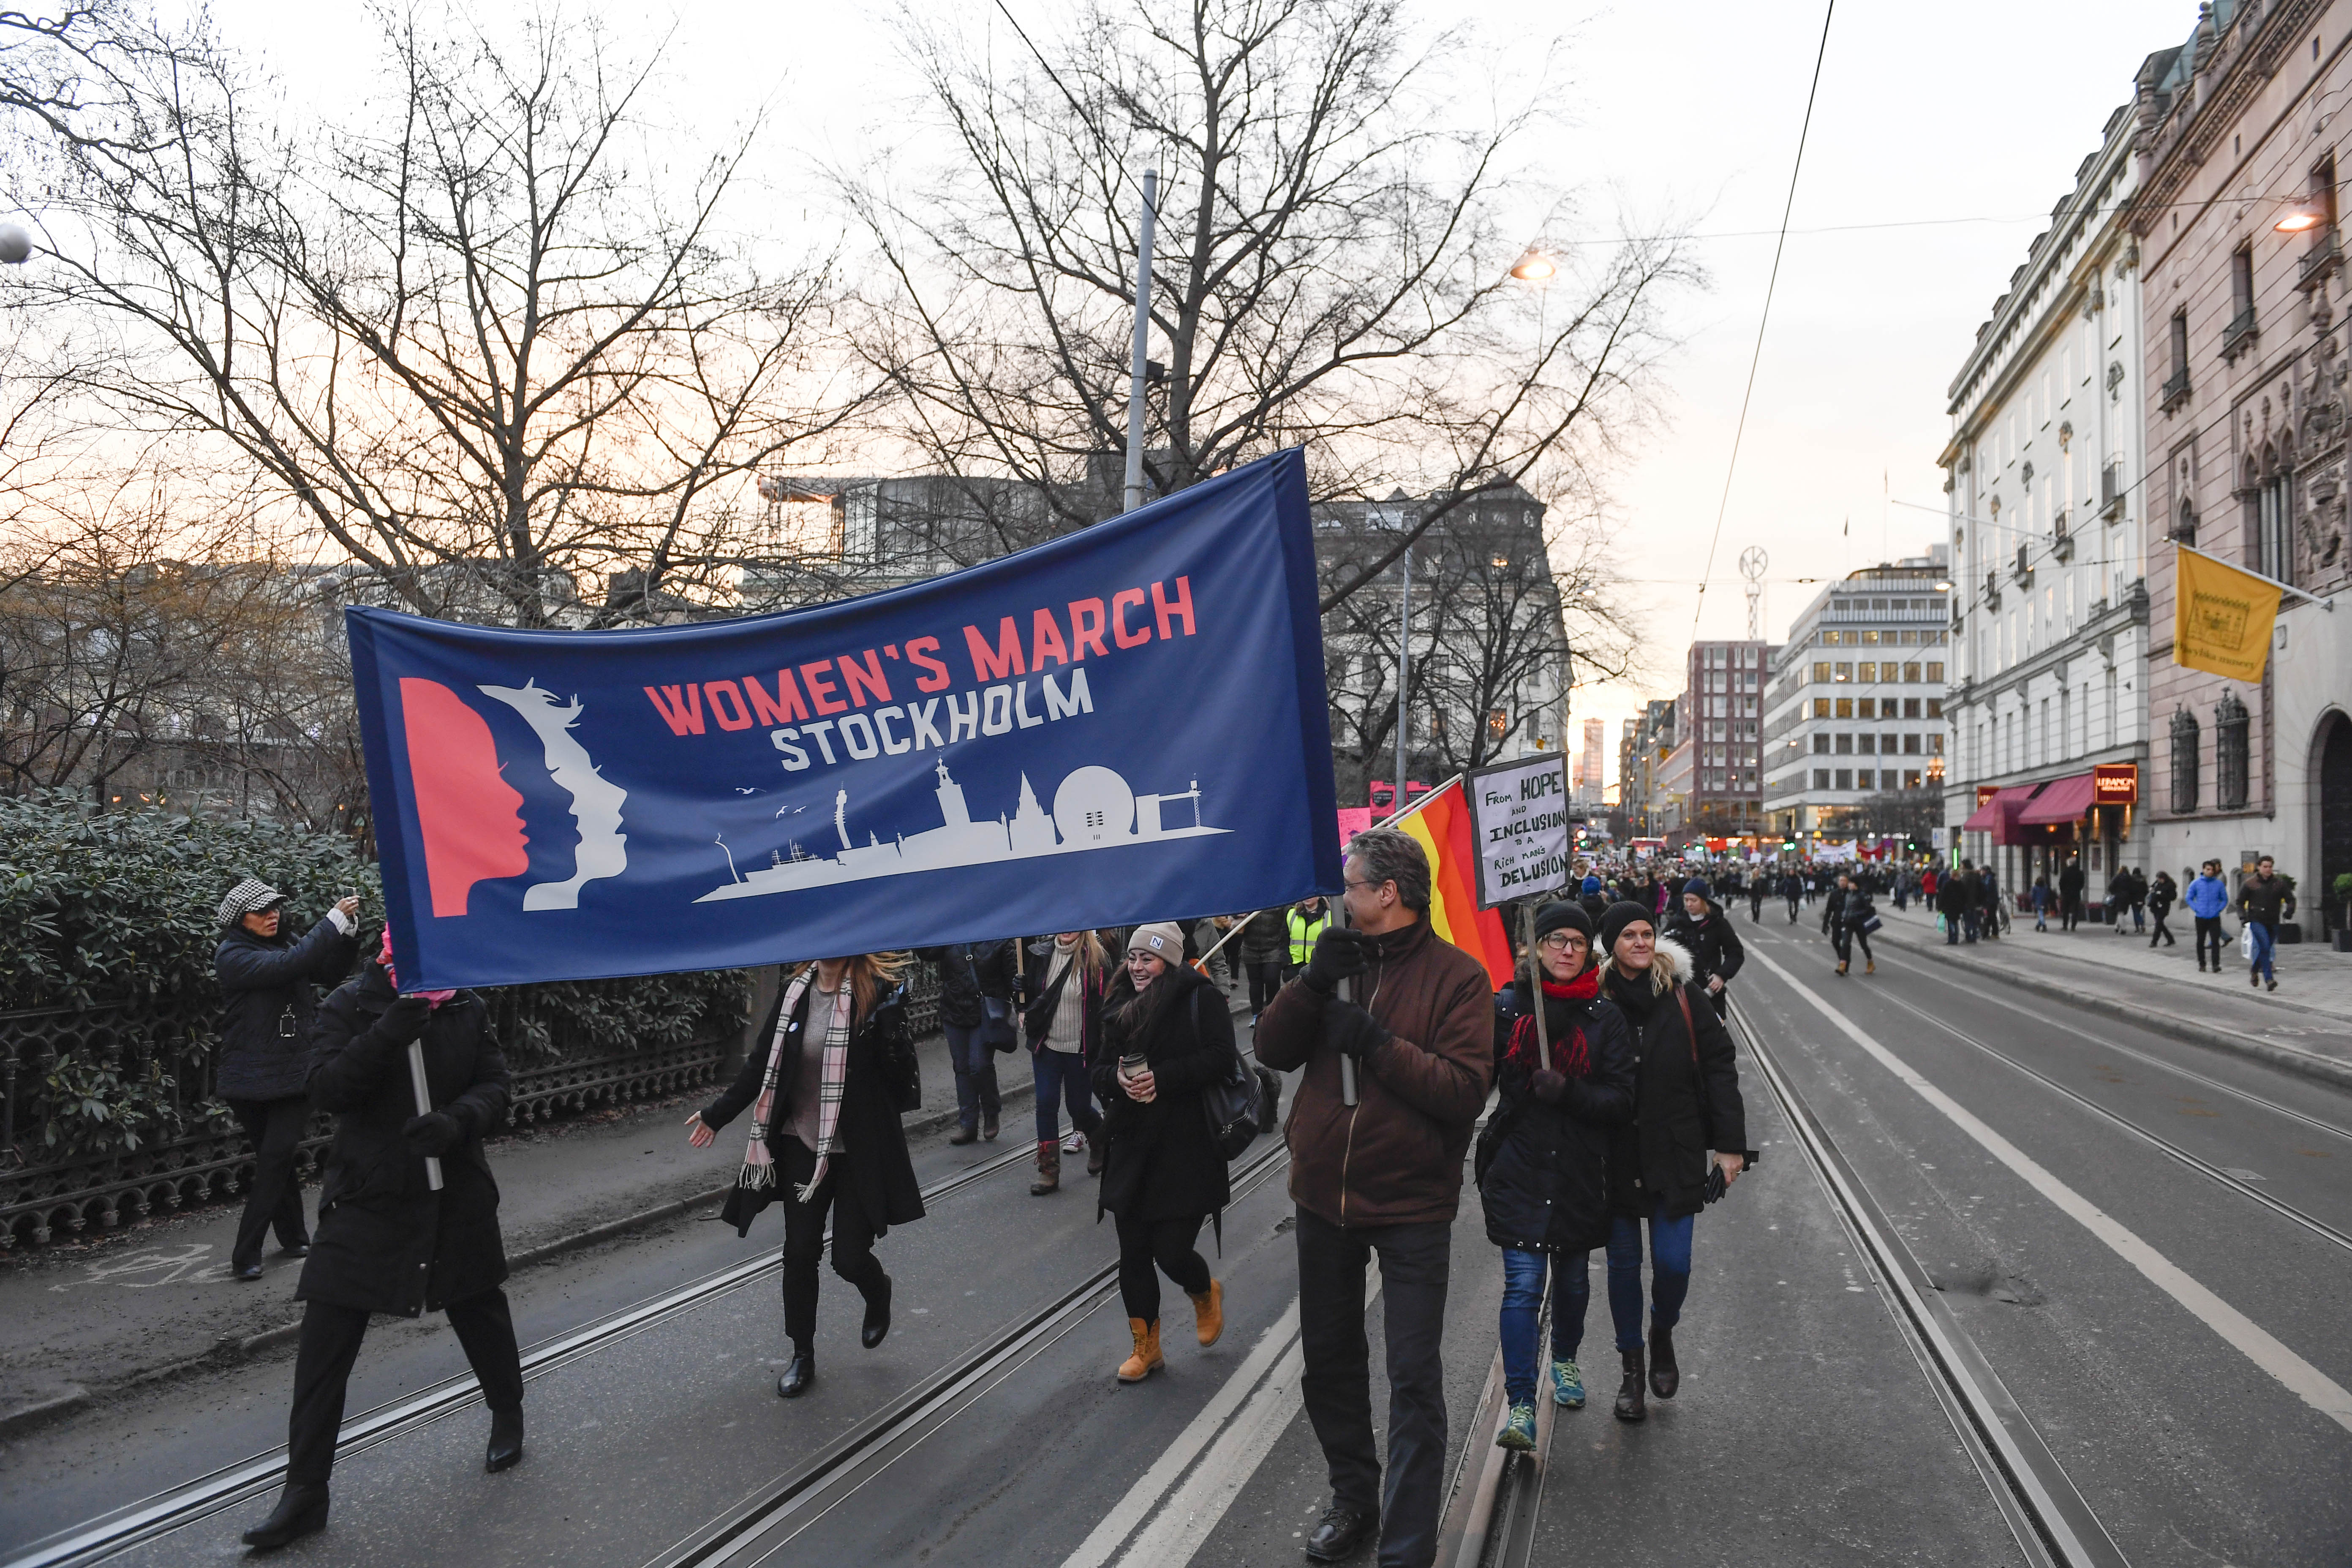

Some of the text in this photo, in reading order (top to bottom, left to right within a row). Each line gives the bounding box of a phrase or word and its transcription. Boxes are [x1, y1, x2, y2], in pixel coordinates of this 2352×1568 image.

[644, 576, 1195, 736] WOMEN'S MARCH
[771, 668, 1094, 771] STOCKHOLM
[1521, 770, 1562, 801] HOPE
[2097, 777, 2135, 787] LEBANON
[1490, 810, 1565, 843] INCLUSION
[1511, 805, 1527, 817] AND
[1499, 852, 1568, 887] DELUSION
[1152, 937, 1161, 946] N
